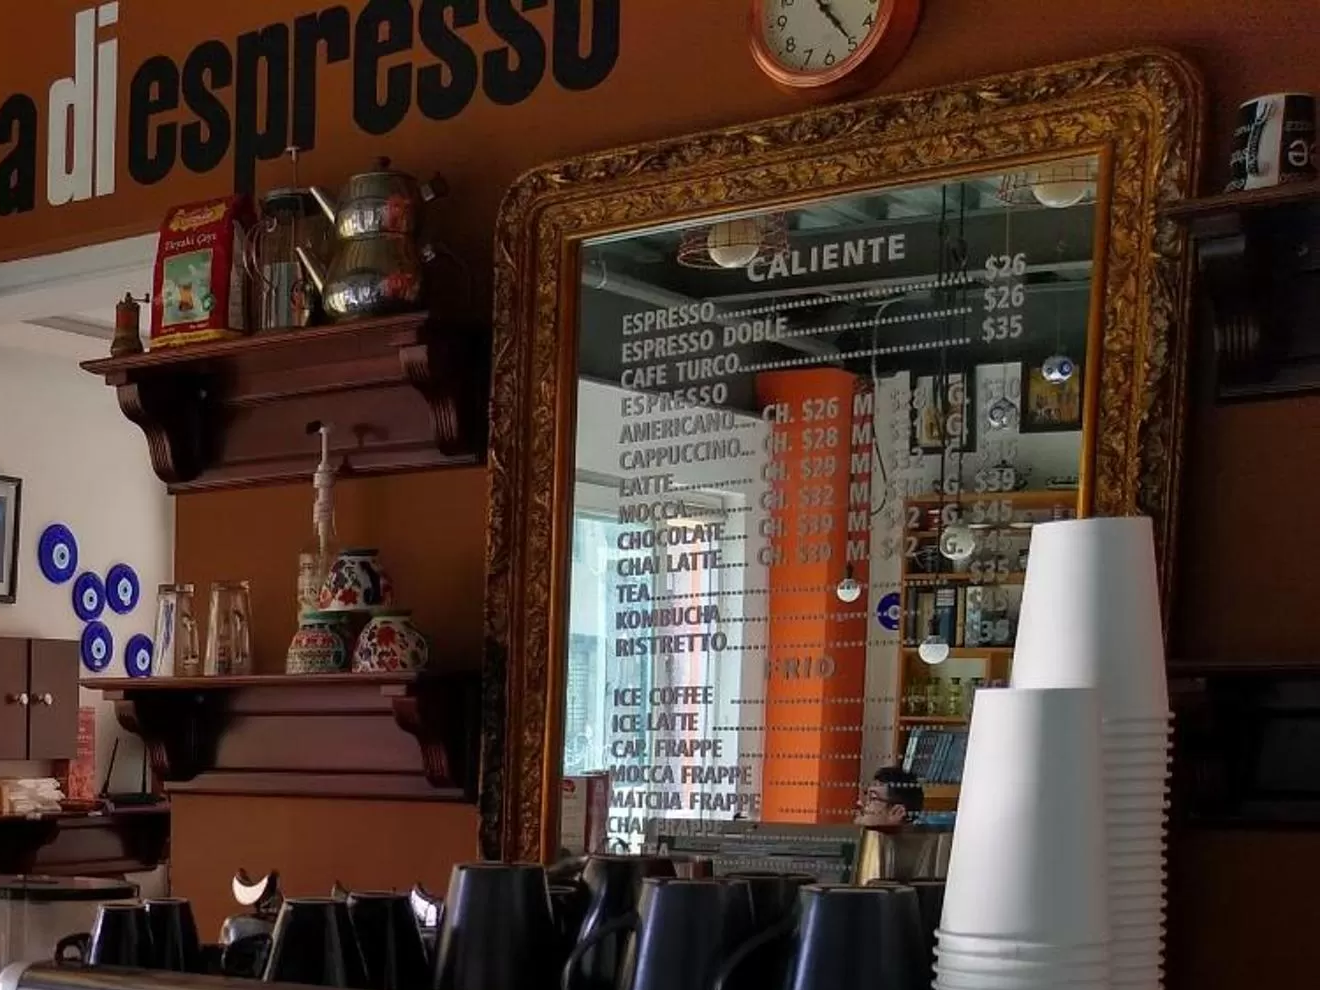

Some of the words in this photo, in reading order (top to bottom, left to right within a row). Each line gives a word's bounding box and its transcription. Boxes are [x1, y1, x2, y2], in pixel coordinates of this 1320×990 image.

[786, 36, 796, 53] 8
[803, 49, 813, 65] 7
[824, 51, 835, 66] 6
[47, 1, 120, 207] di
[128, 0, 620, 197] espresso
[747, 233, 906, 283] CALIENTE
[622, 301, 715, 336] ESPRESSO
[985, 252, 1027, 281] $26
[621, 329, 714, 364] ESPRESSO
[723, 317, 788, 347] DOBLE
[984, 283, 1025, 312] $26
[621, 364, 667, 389] CAFE
[676, 353, 740, 383] TURCO
[982, 314, 1023, 344] $35
[620, 383, 728, 418] ESPRESSO
[618, 411, 735, 444] AMERICANO
[801, 396, 839, 422] $26
[618, 437, 742, 471] CAPPUCCINO
[618, 472, 674, 498] LATTE
[618, 499, 687, 525] MOCCA
[616, 522, 727, 551] CHOCOLATE
[616, 555, 660, 578] CHAI
[666, 549, 723, 574] LATTE
[615, 582, 650, 604] TEA
[615, 604, 720, 631] KOMBUCHA
[615, 630, 728, 657] RISTRETTO
[613, 686, 641, 707] ICE
[649, 685, 714, 707] COFFEE
[611, 713, 641, 733] ICE
[647, 712, 699, 732] LATTE
[654, 738, 723, 759] FRAPPE
[610, 764, 675, 784] MOCCA
[681, 764, 753, 786] FRAPPE
[610, 790, 681, 811] MATCHA
[689, 792, 761, 813] FRAPPE
